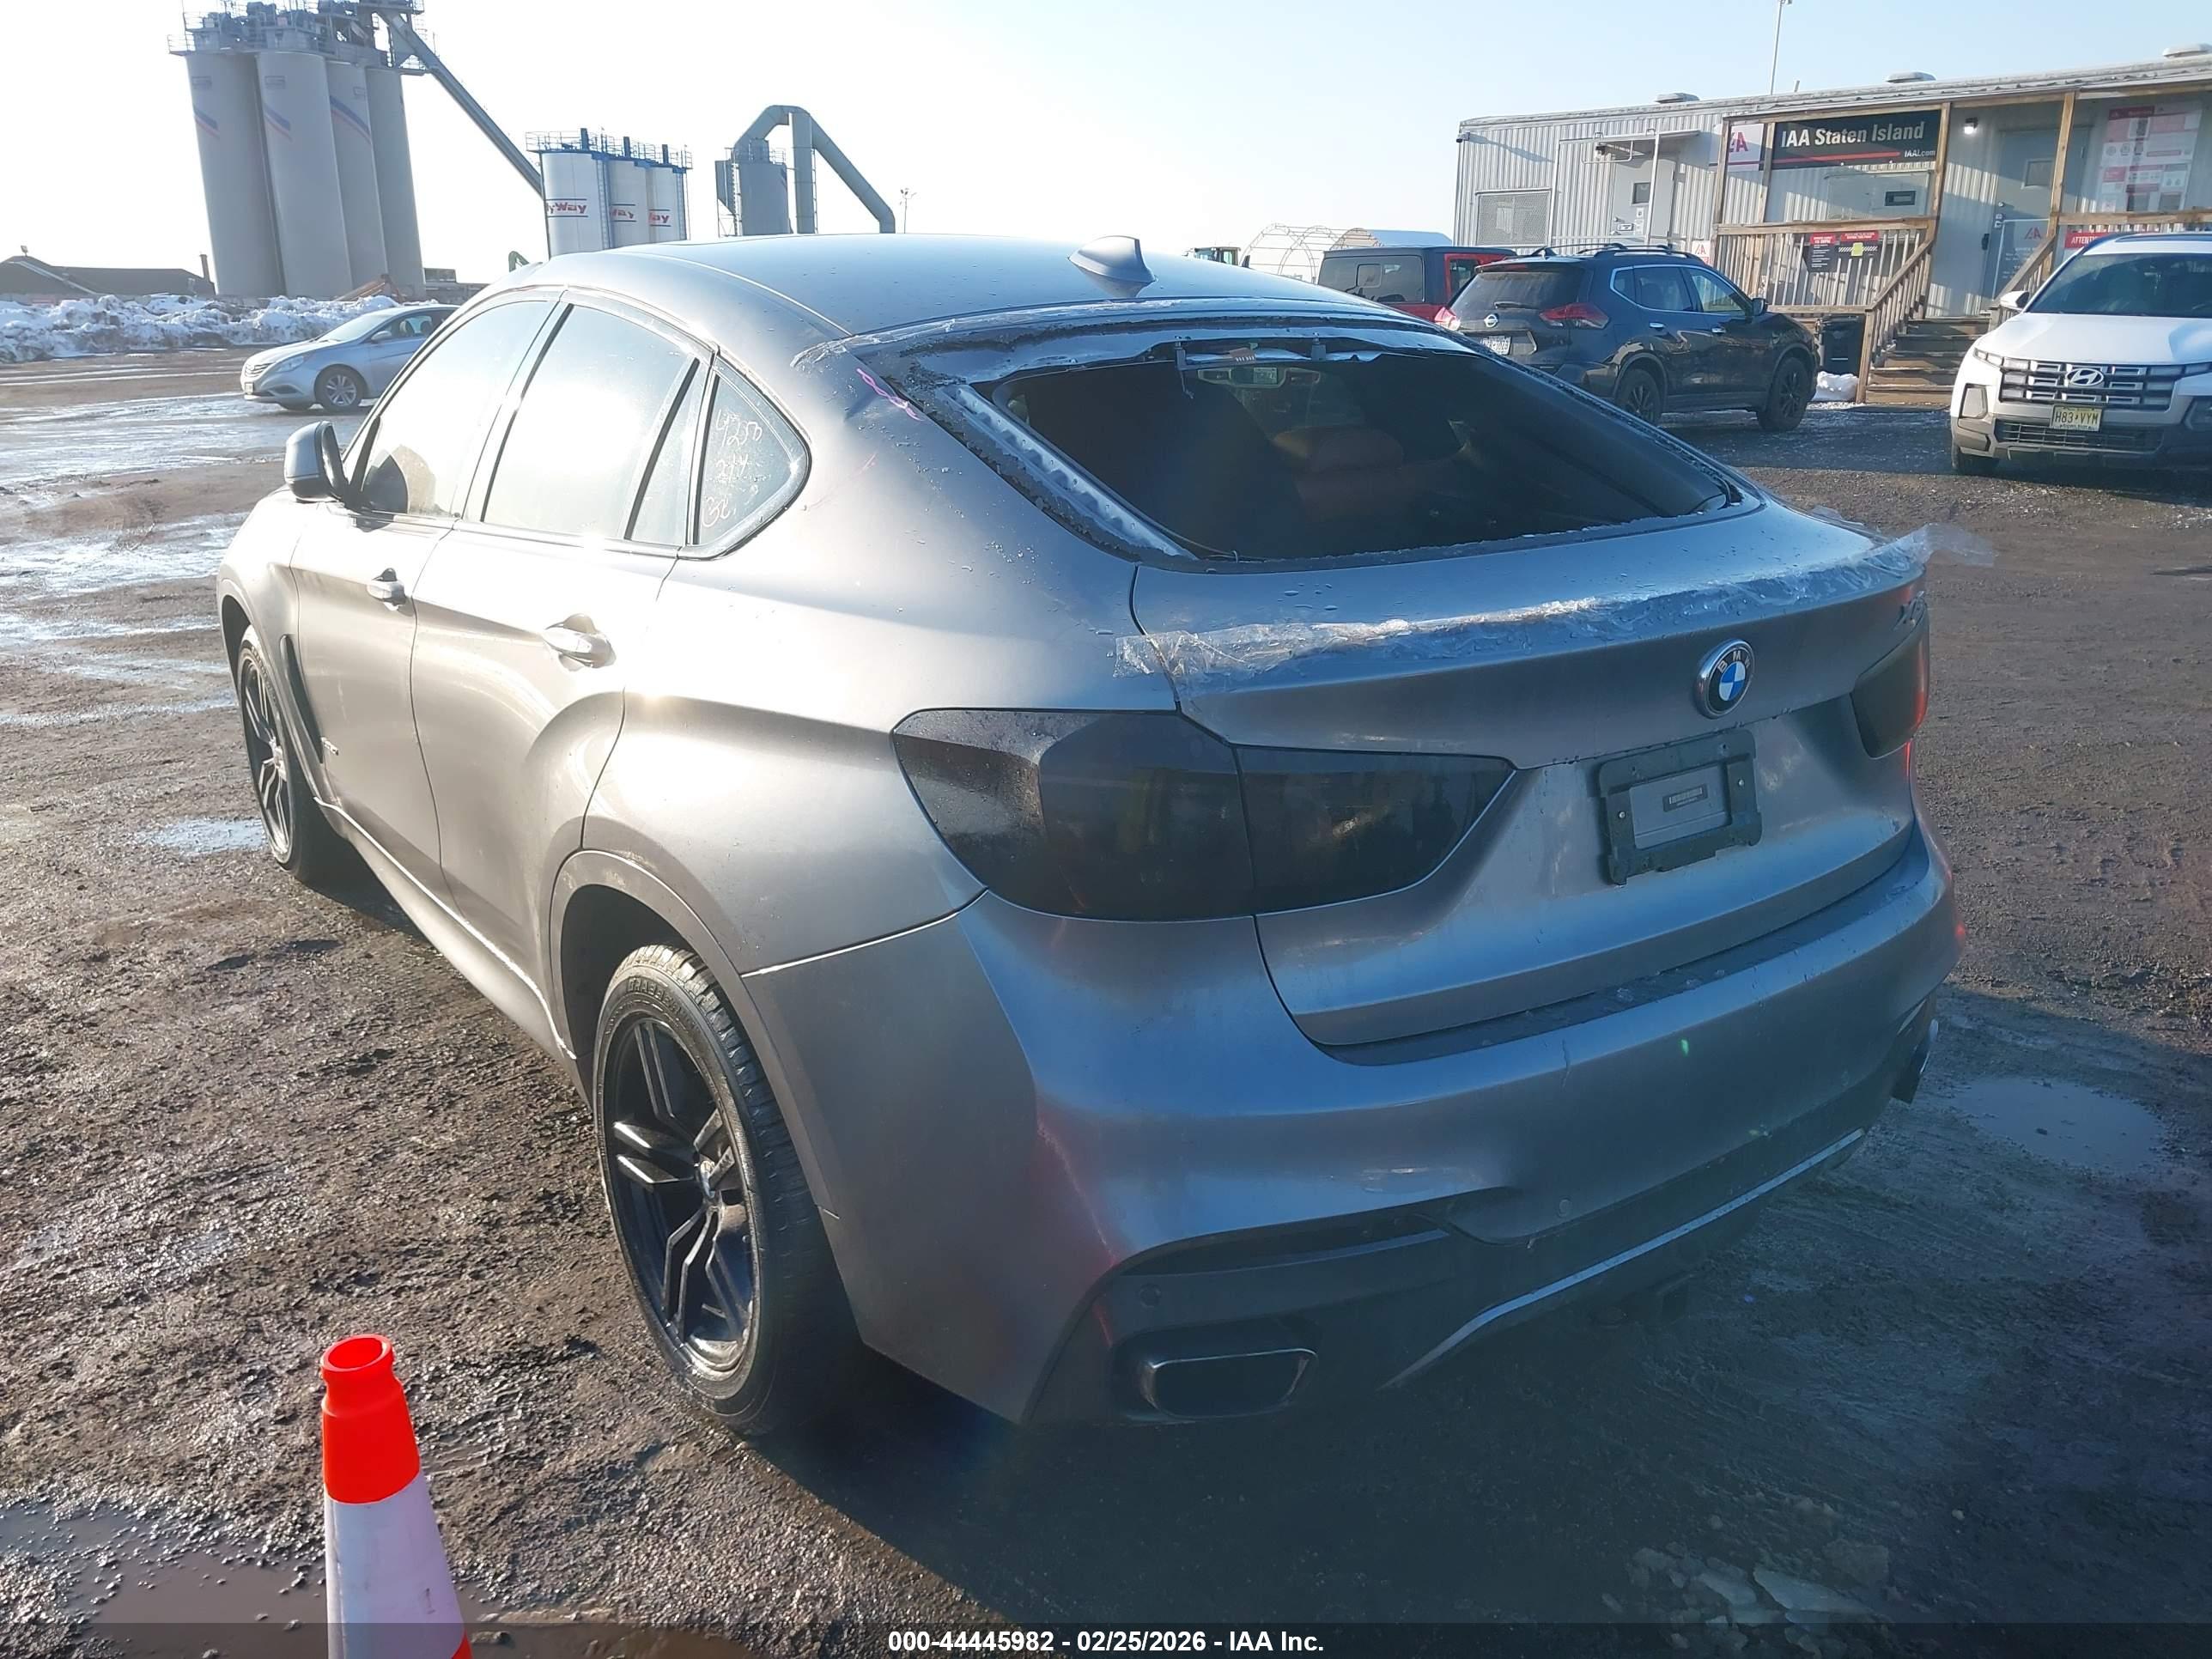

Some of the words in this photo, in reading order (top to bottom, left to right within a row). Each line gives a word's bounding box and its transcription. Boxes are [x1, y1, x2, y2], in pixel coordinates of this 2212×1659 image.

[1782, 129, 1810, 148] IAA
[1814, 127, 1867, 146] Staten
[1872, 121, 1925, 143] Island
[2055, 411, 2074, 423] H83
[1717, 650, 1751, 673] BMW
